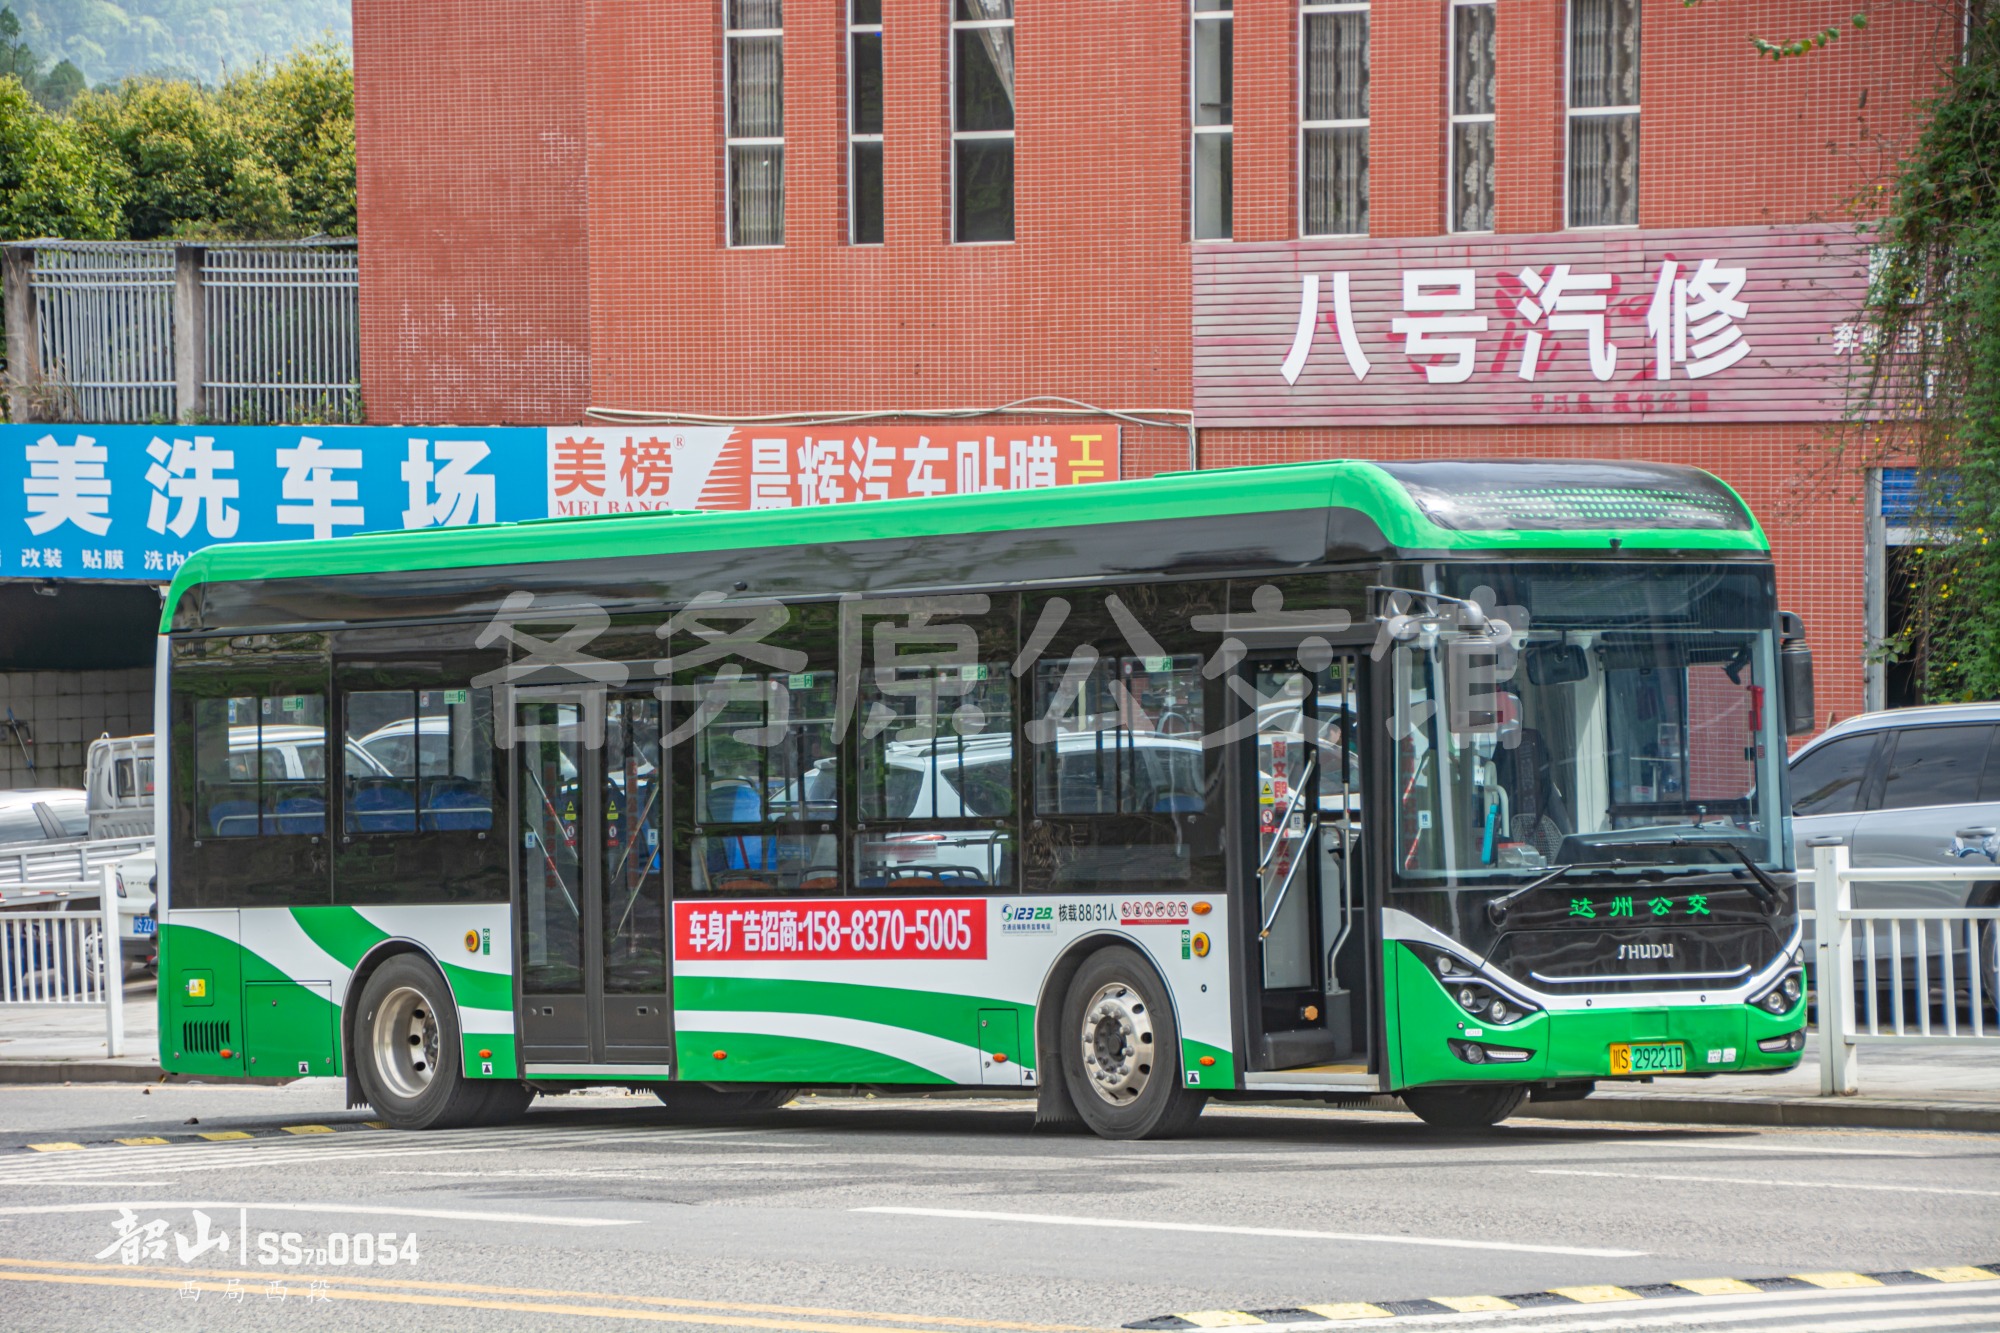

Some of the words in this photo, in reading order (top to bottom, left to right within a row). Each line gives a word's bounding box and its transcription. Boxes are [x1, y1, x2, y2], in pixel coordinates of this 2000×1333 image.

[1281, 258, 1751, 386] 八号汽修
[554, 436, 673, 497] 美榜
[23, 434, 496, 539] 美洗车场
[21, 548, 62, 568] 改装
[82, 549, 124, 570] 贴膜
[1059, 903, 1117, 922] 核载88/31人
[1569, 894, 1711, 919] 达州公交
[1618, 943, 1674, 960] SHUDU
